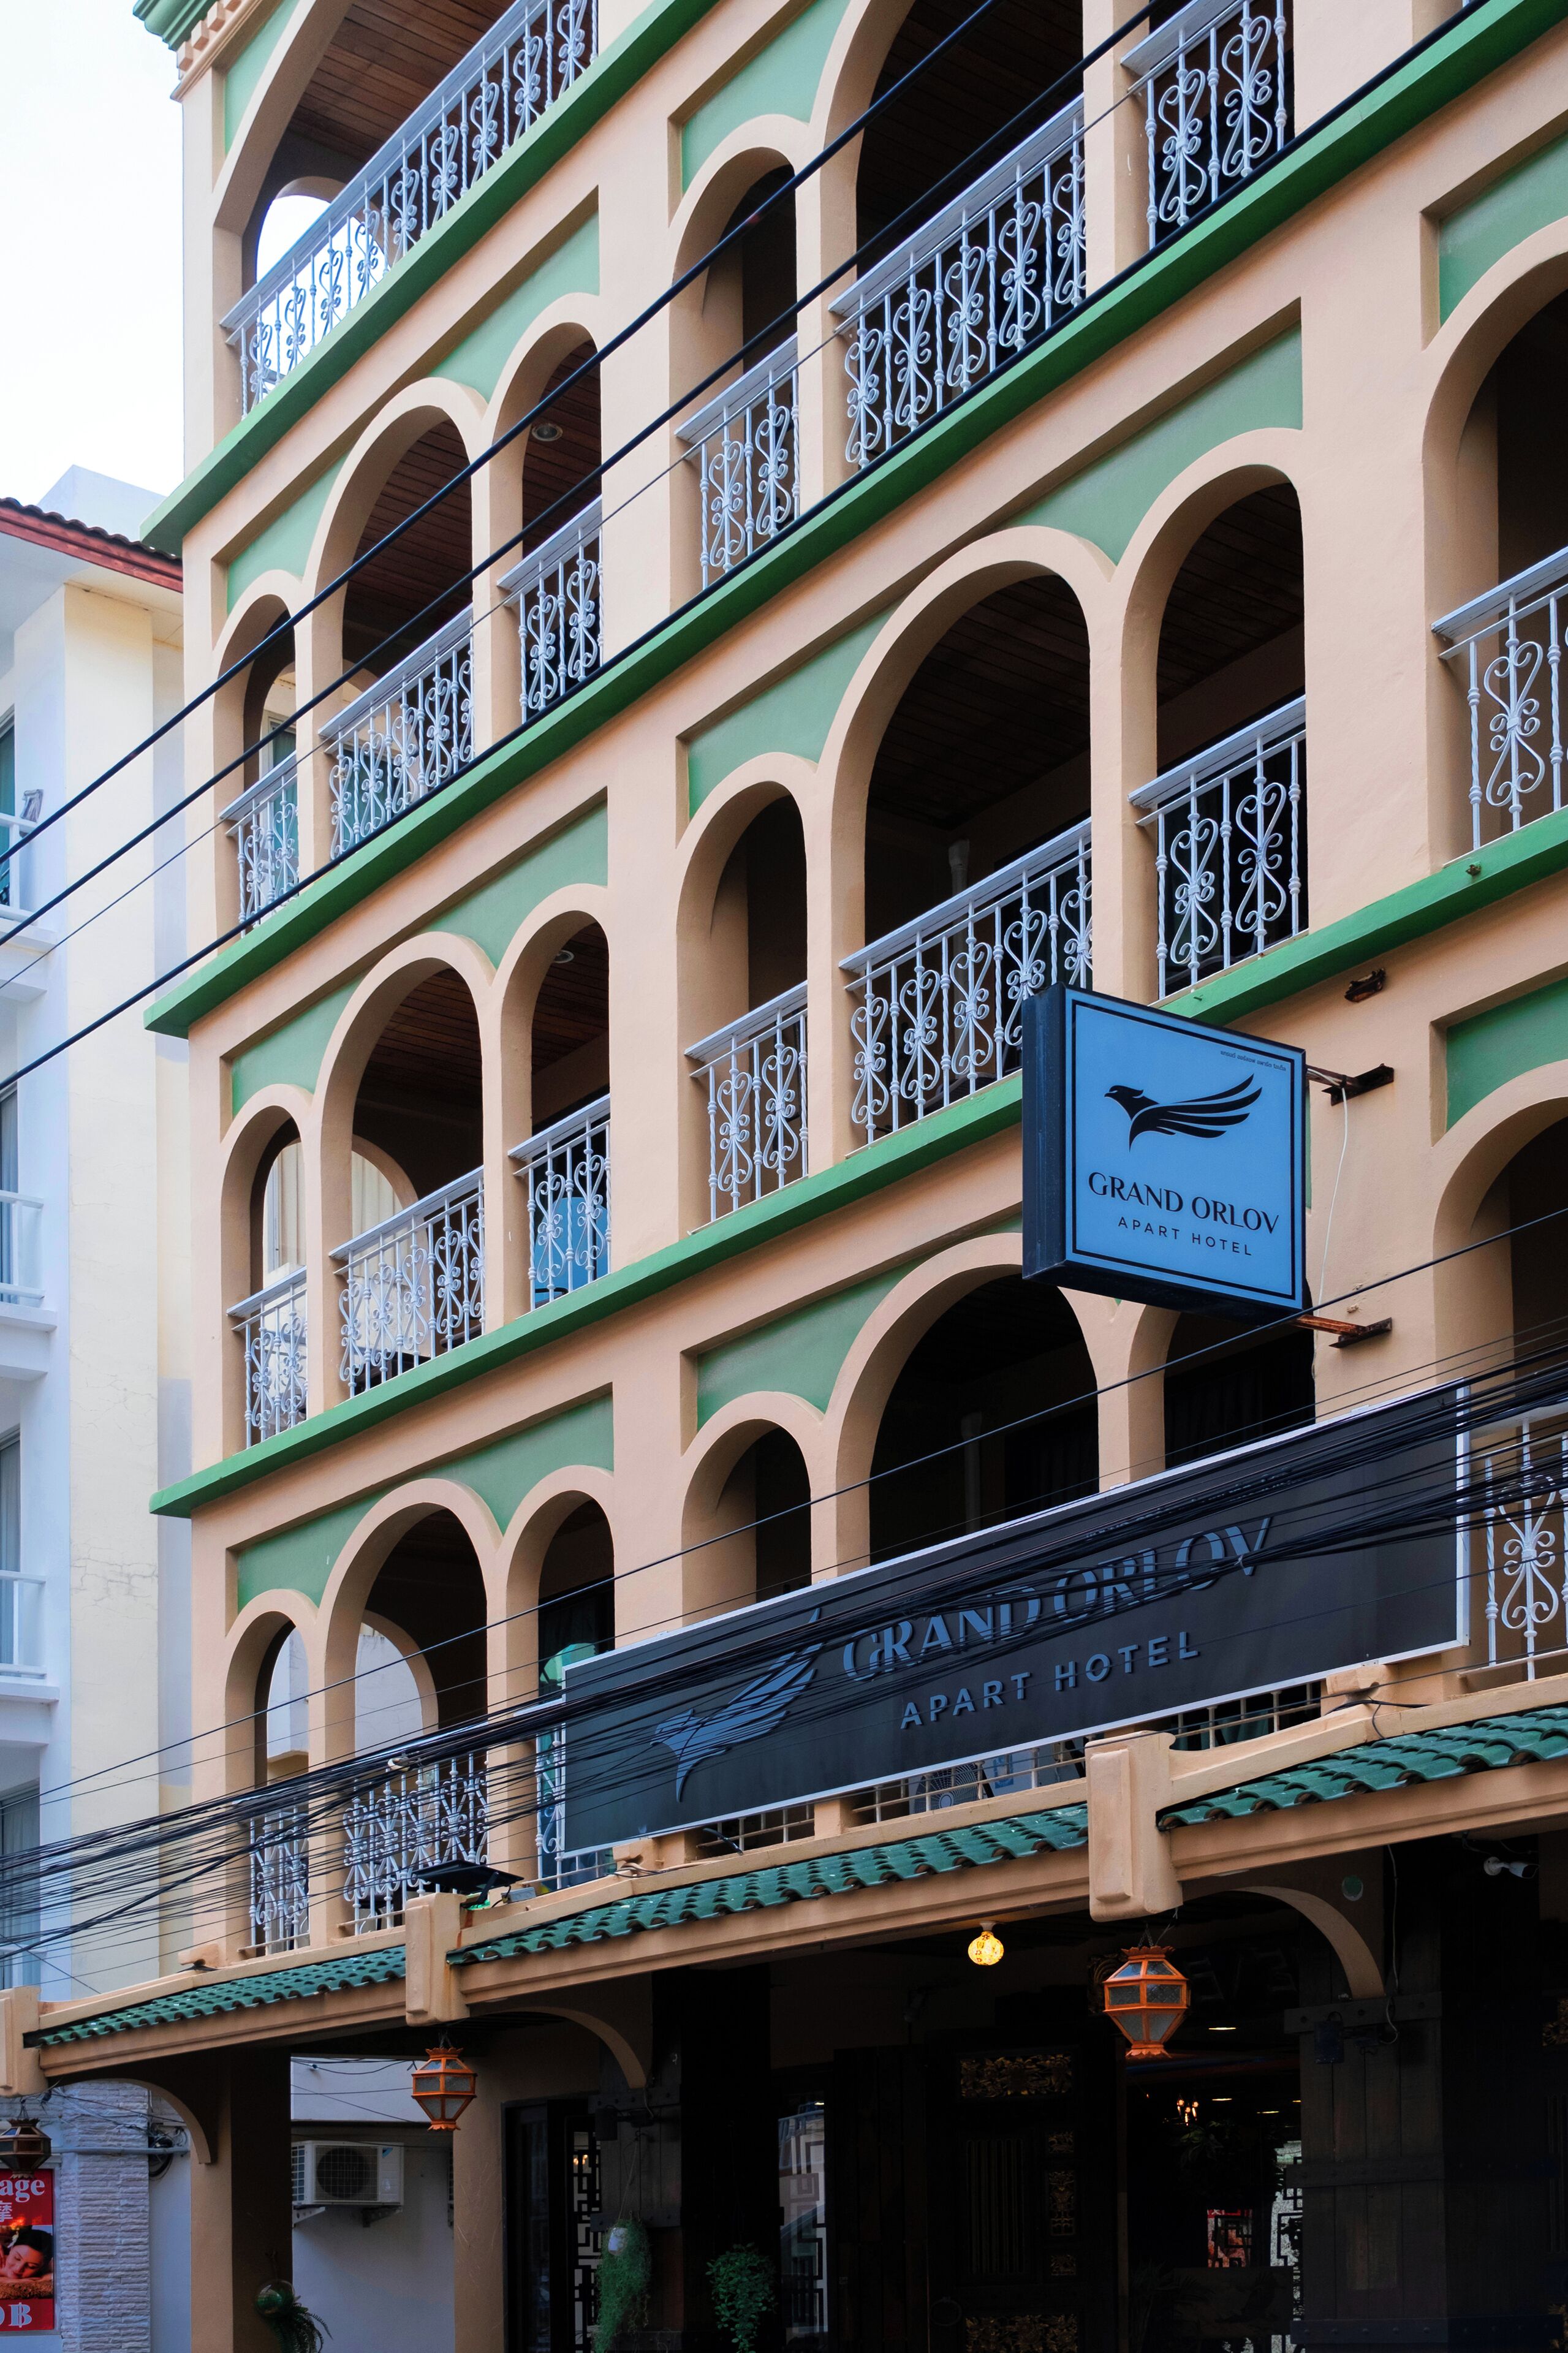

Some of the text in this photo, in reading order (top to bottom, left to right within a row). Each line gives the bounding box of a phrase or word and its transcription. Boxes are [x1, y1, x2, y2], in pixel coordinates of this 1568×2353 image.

[1088, 1172, 1279, 1234] GRAND ORLOV
[1118, 1216, 1252, 1256] APART HOTEL
[843, 1517, 1272, 1681] GRAND ORLOV
[900, 1630, 1200, 1729] APART HOTEL
